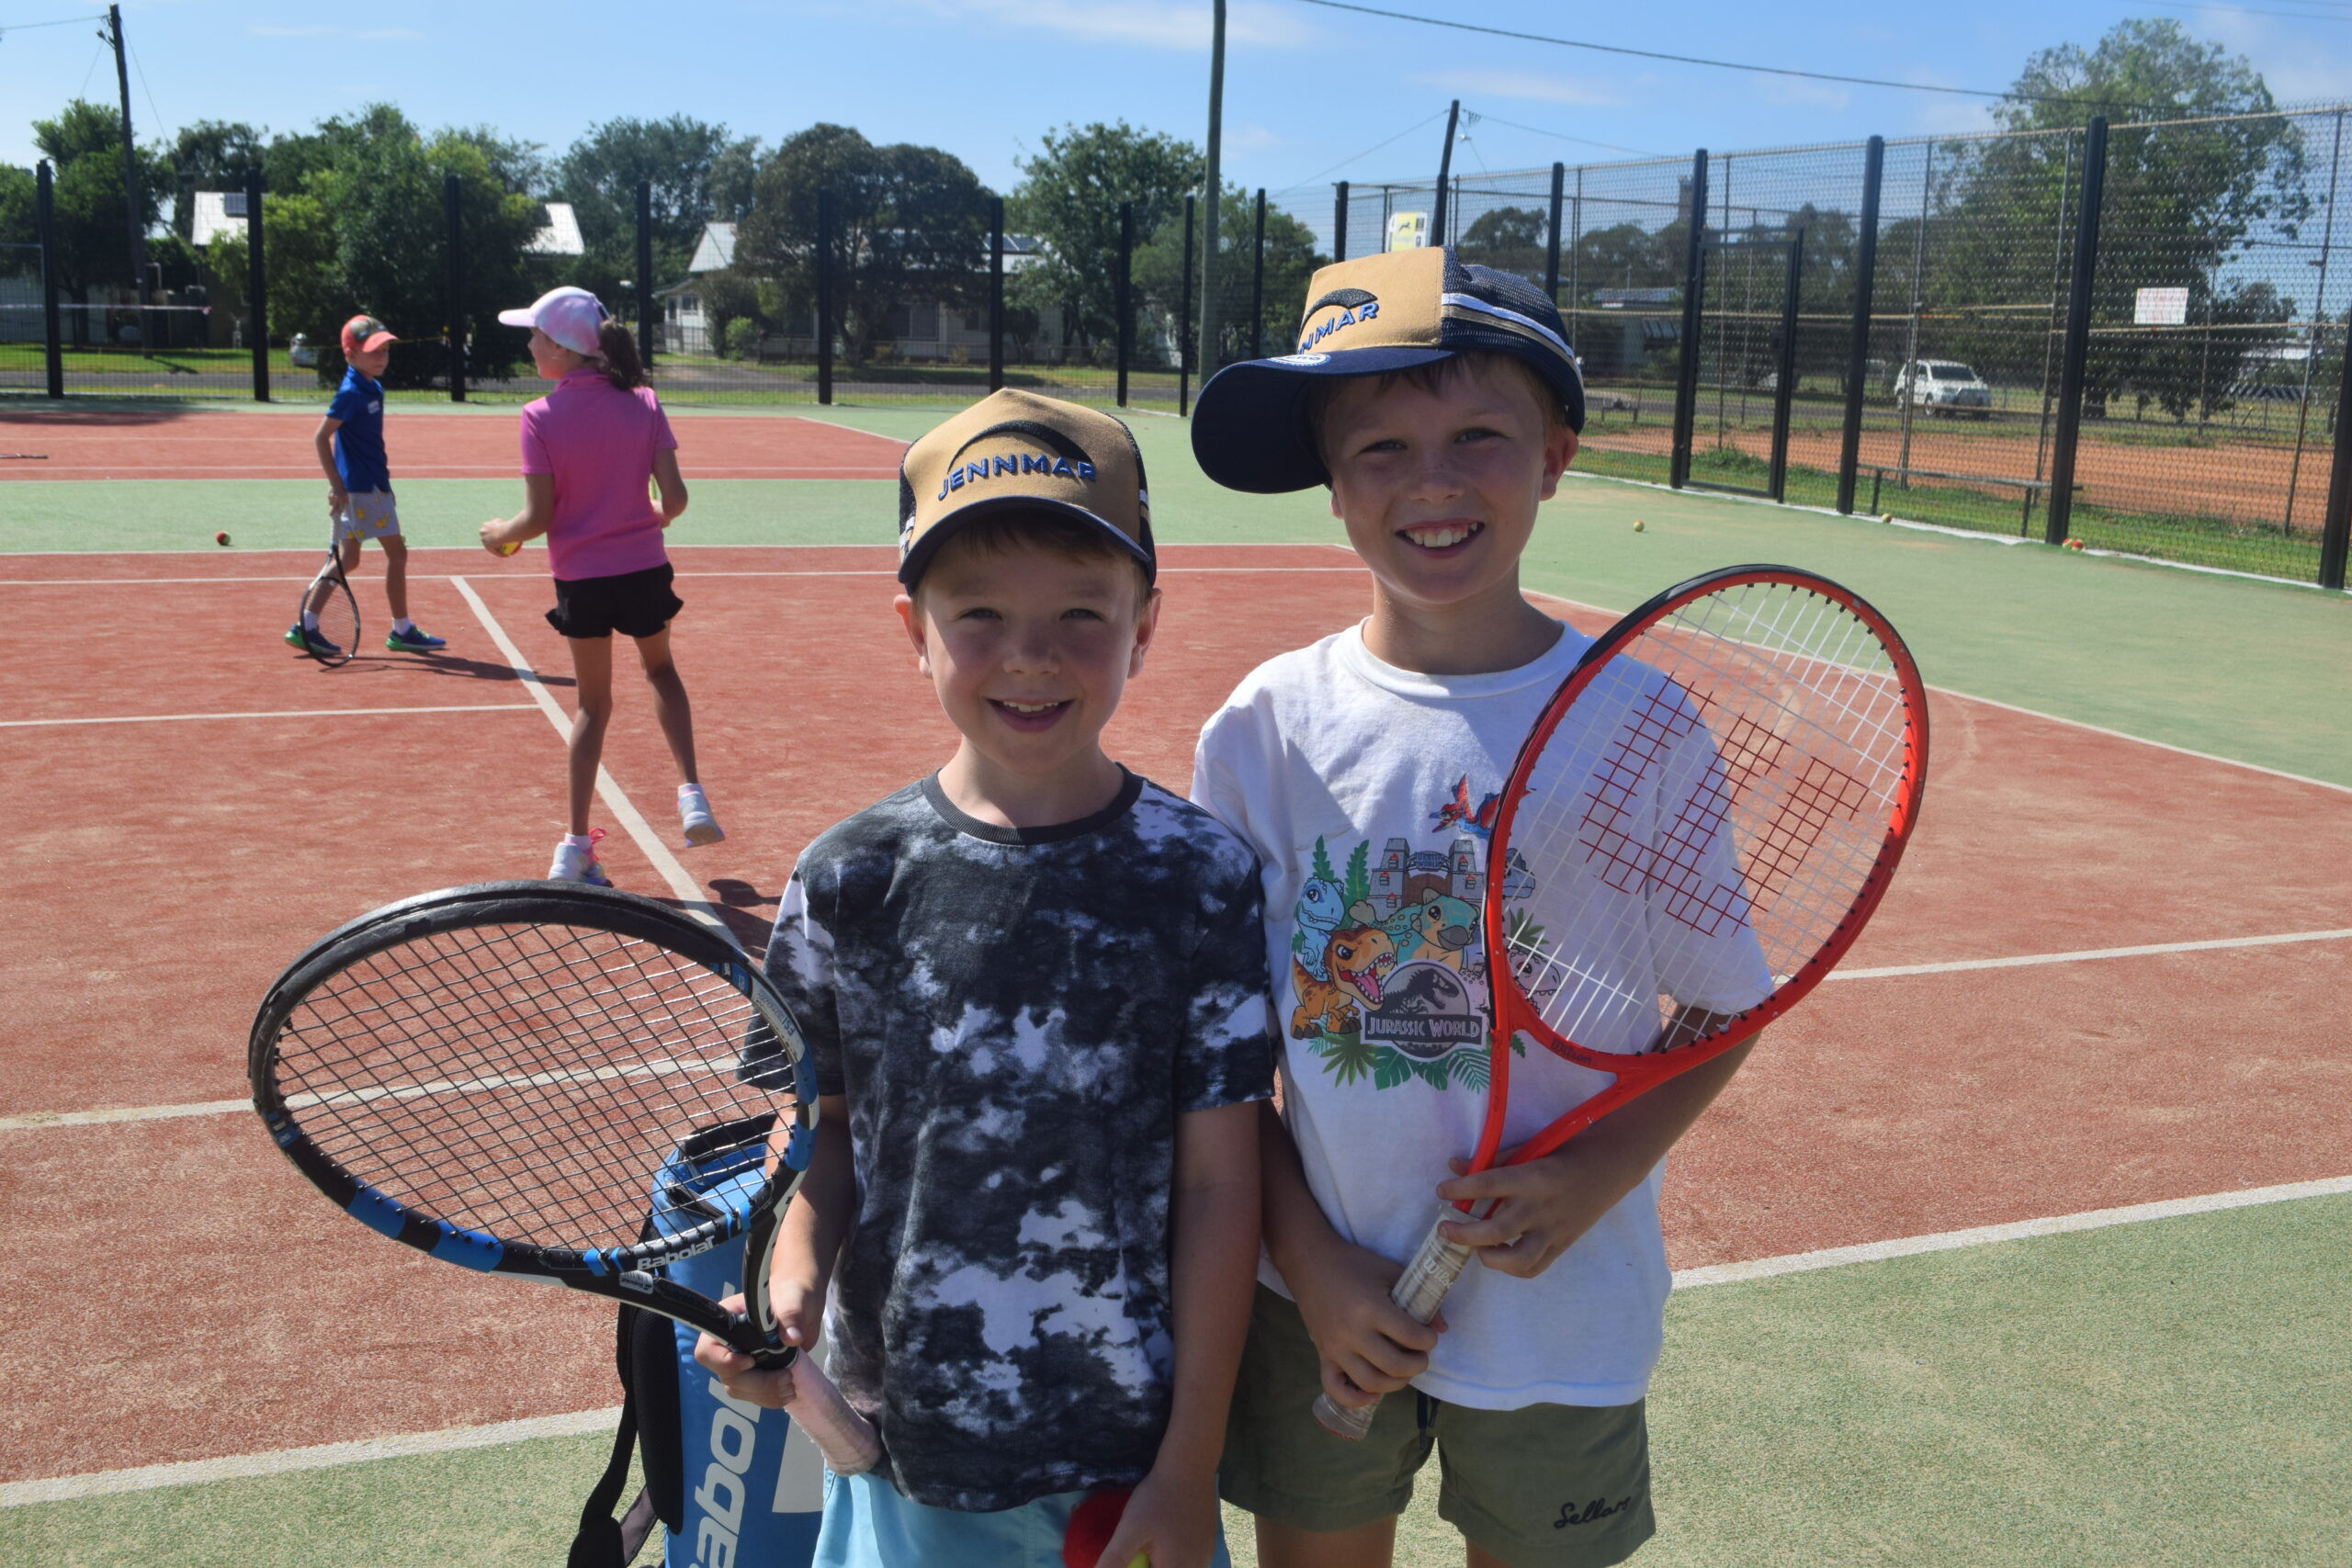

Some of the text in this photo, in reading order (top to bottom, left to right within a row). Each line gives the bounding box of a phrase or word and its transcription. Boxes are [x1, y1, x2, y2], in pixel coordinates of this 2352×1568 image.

[937, 453, 1097, 501] JENNMAR
[1366, 1017, 1482, 1038] JURASSIC WORLD
[1551, 1037, 1593, 1066] Wilson
